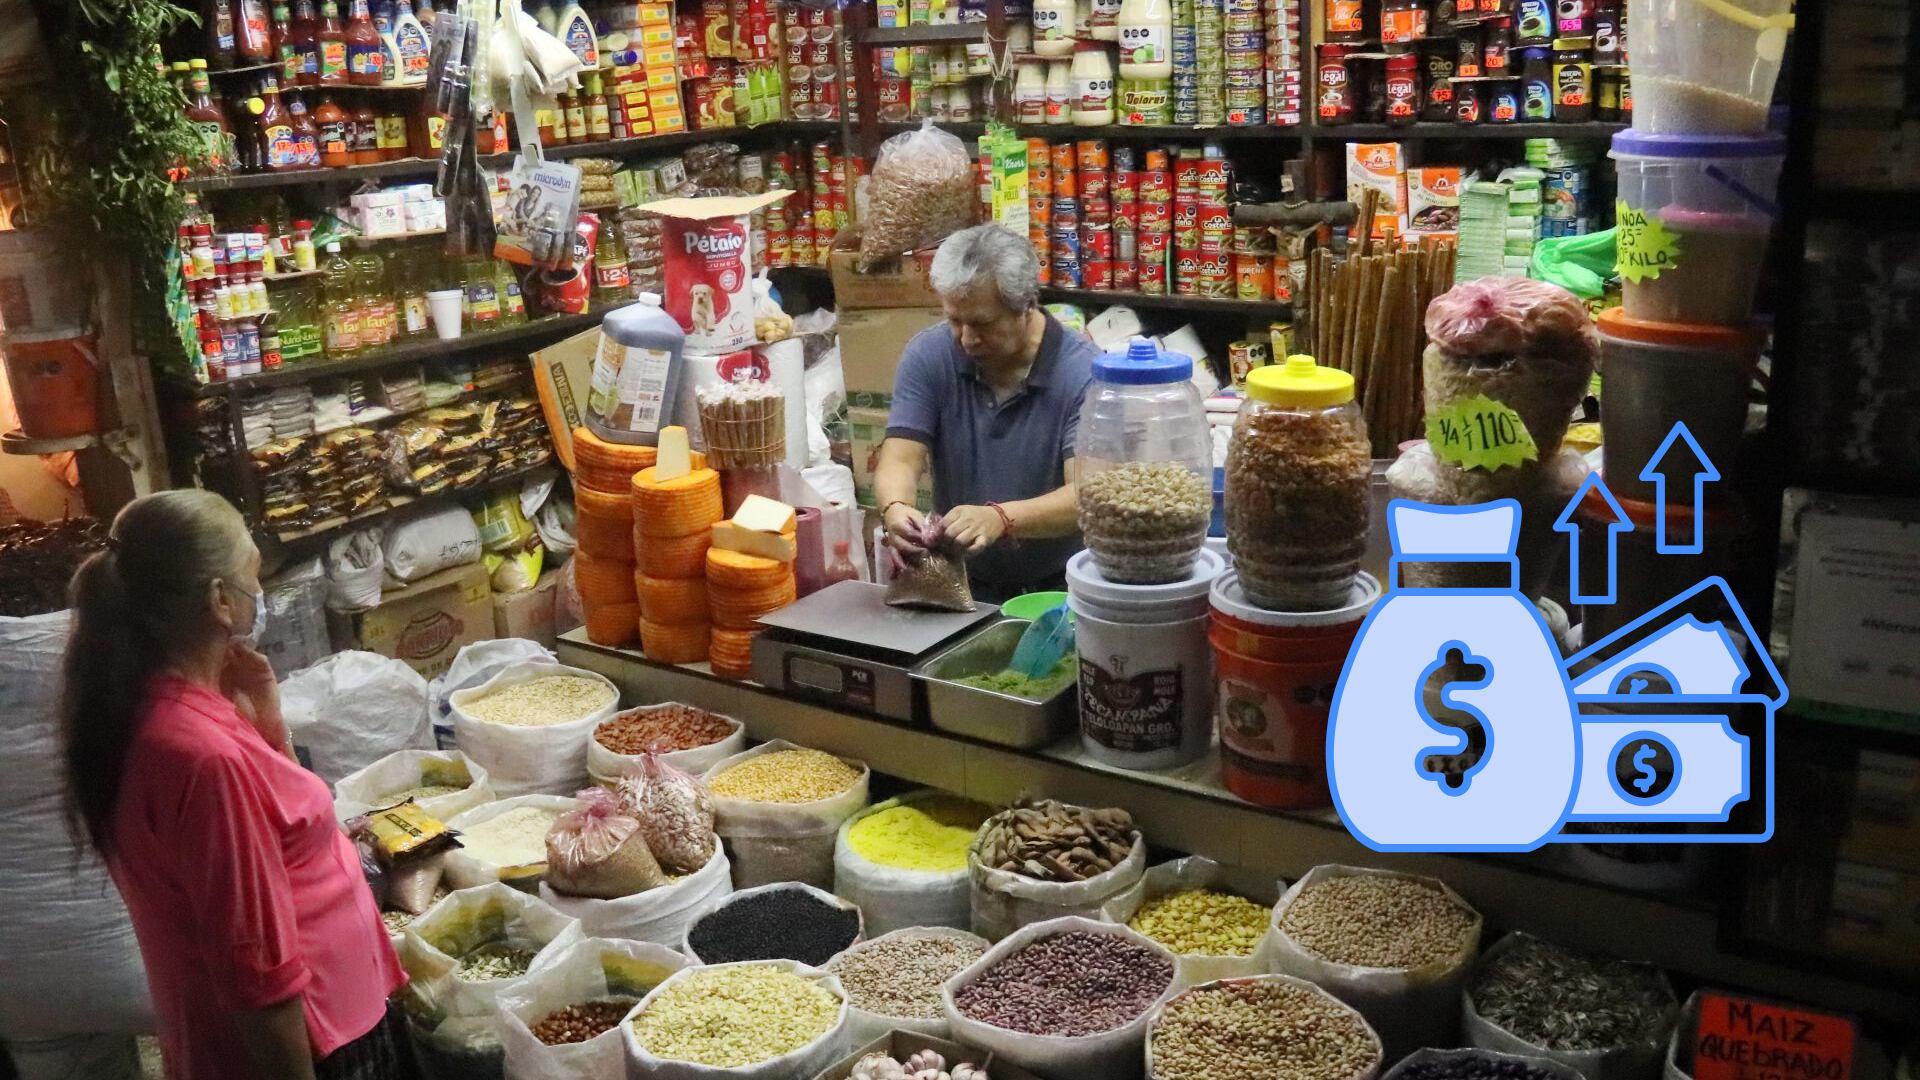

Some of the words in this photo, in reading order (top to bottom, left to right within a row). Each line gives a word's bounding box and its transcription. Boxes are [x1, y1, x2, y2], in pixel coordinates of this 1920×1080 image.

[1428, 61, 1453, 71] ORO
[1320, 70, 1346, 86] Legal
[1387, 83, 1412, 98] Legal
[1006, 158, 1025, 169] Knorr
[534, 173, 572, 190] microdyn
[683, 232, 742, 254] Pétalo
[1629, 250, 1668, 267] KILO
[1728, 1001, 1818, 1046] MAIZ
